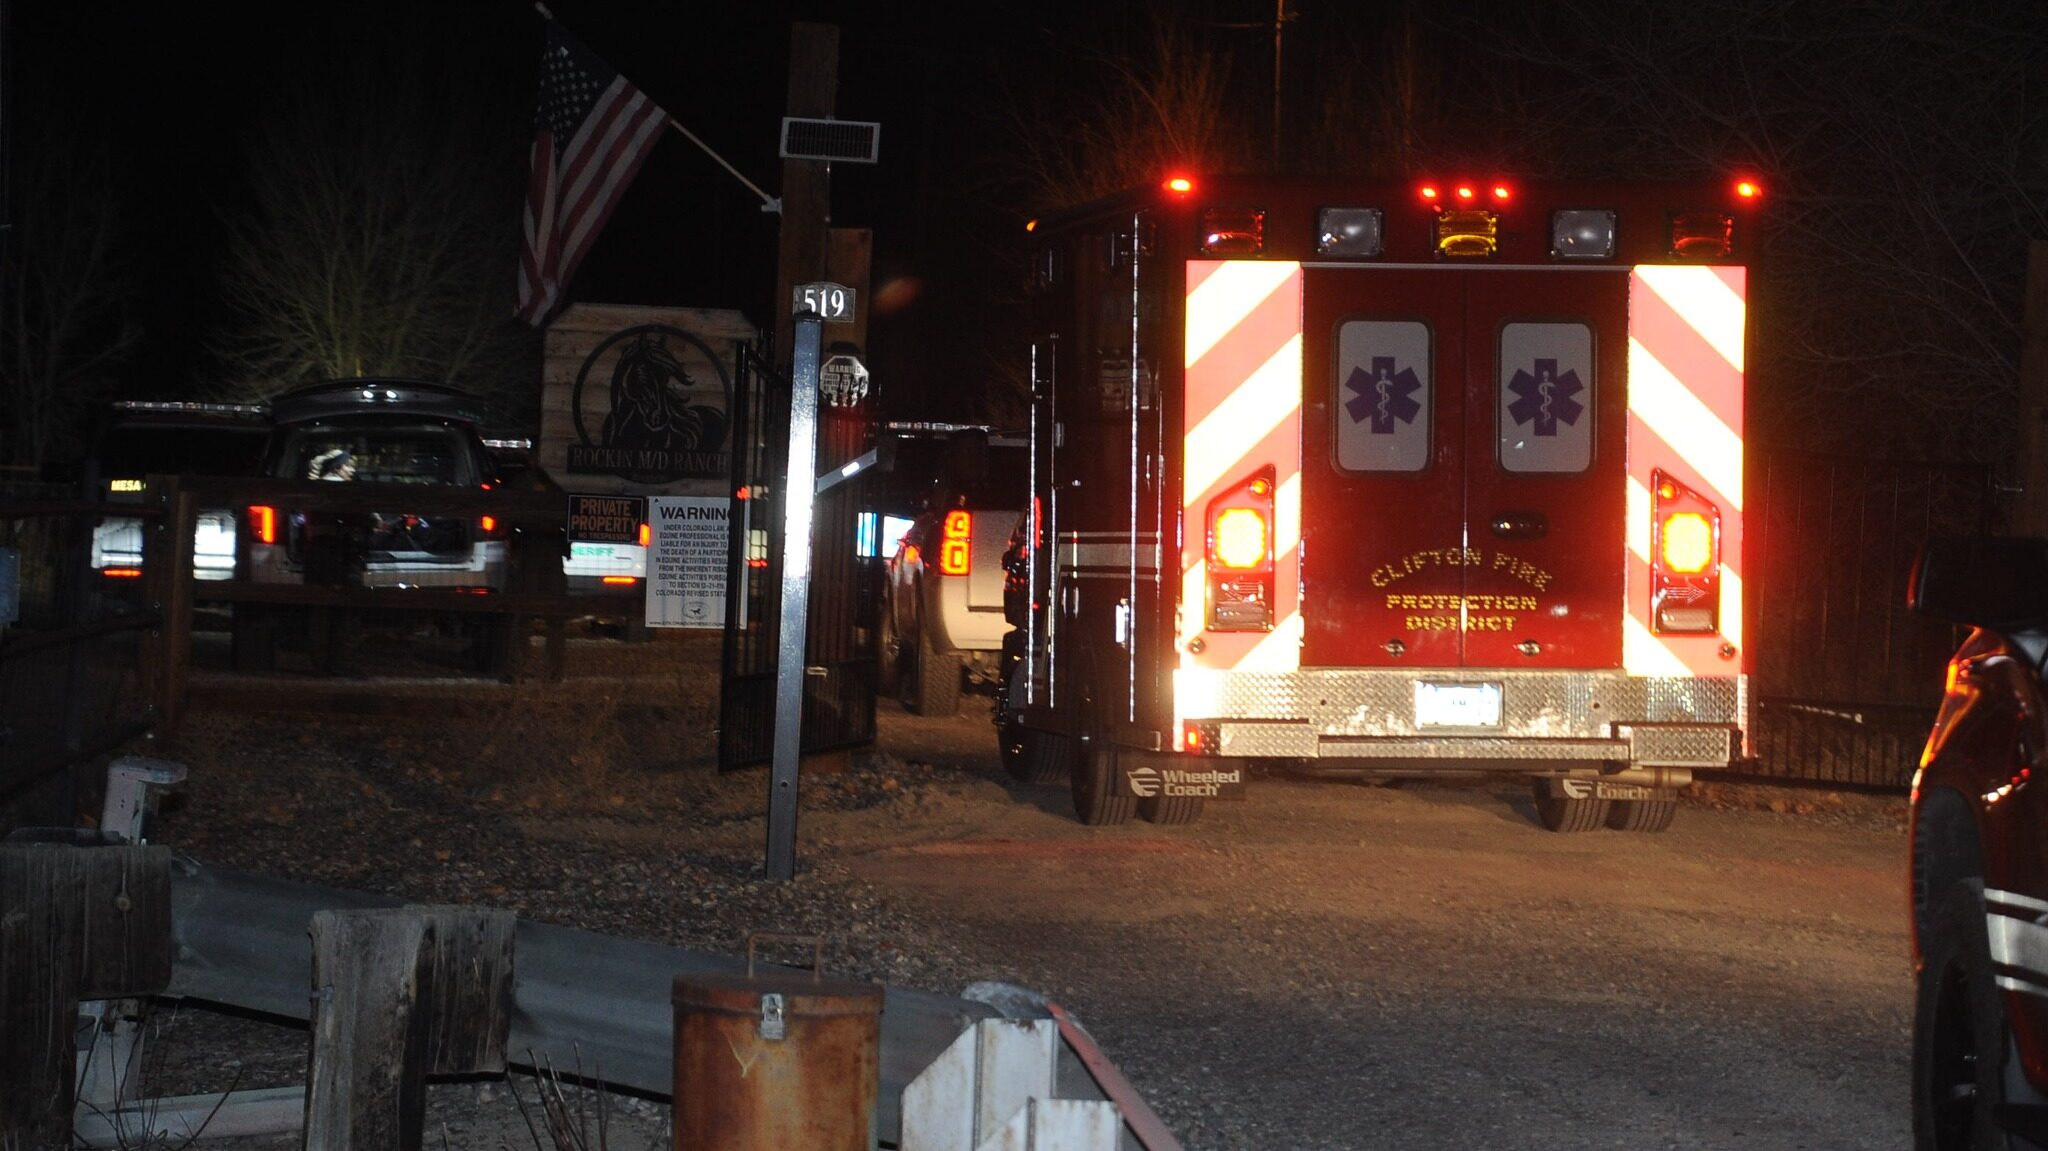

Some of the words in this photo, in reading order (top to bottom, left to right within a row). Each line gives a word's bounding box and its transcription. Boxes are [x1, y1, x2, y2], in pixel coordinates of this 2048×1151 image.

[804, 289, 844, 317] 519
[573, 448, 633, 468] ROCKIN
[673, 452, 728, 473] RANCH
[110, 480, 142, 491] MESA
[580, 498, 632, 516] PRIVATE
[660, 506, 730, 520] WARNIN
[571, 515, 639, 533] PROPERTY
[664, 524, 681, 532] UNDER
[682, 524, 712, 532] COLORADO
[1370, 547, 1482, 587] CLIFTON
[1493, 552, 1553, 592] FIRE
[1386, 594, 1537, 611] PROTECTION
[1406, 615, 1517, 631] DISTRICT
[1162, 769, 1240, 784] Wheeled
[1164, 783, 1218, 796] Coach
